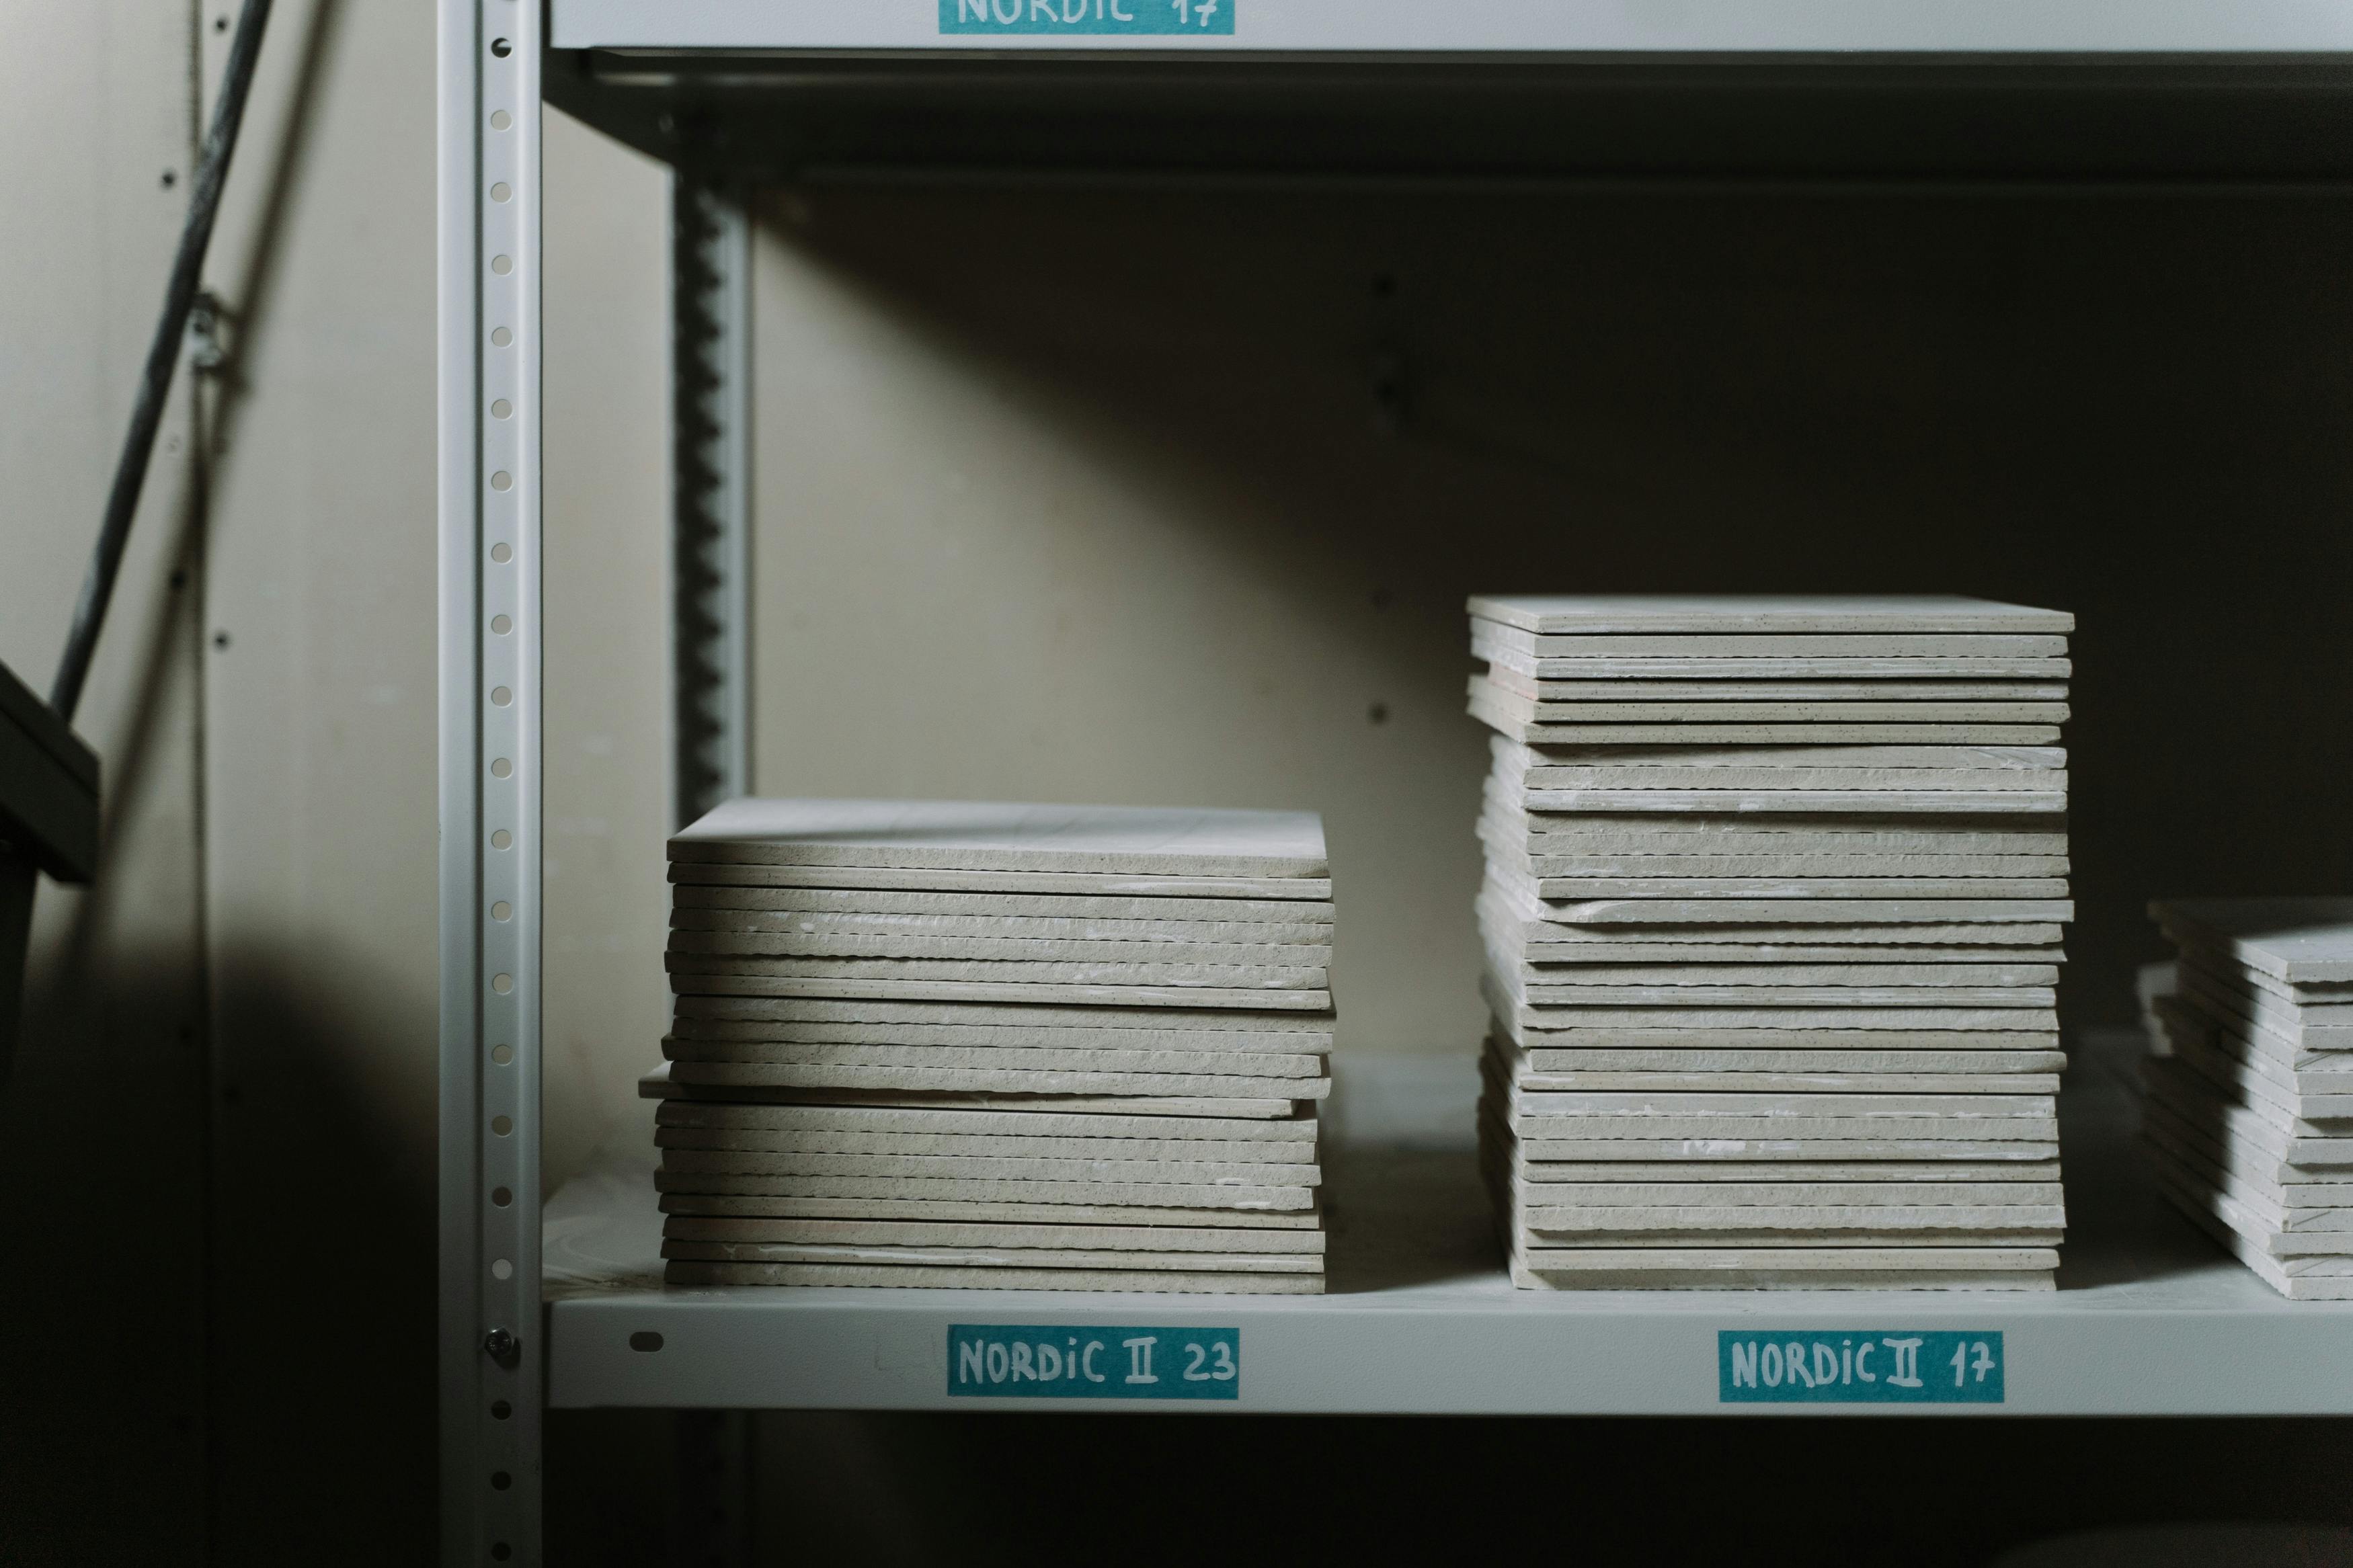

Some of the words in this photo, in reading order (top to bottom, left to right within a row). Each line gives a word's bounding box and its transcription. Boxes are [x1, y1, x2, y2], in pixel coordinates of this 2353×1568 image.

[1122, 1336, 1159, 1384] II
[1183, 1342, 1236, 1380] 23
[1882, 1337, 1924, 1387] II
[1950, 1341, 1995, 1387] 17
